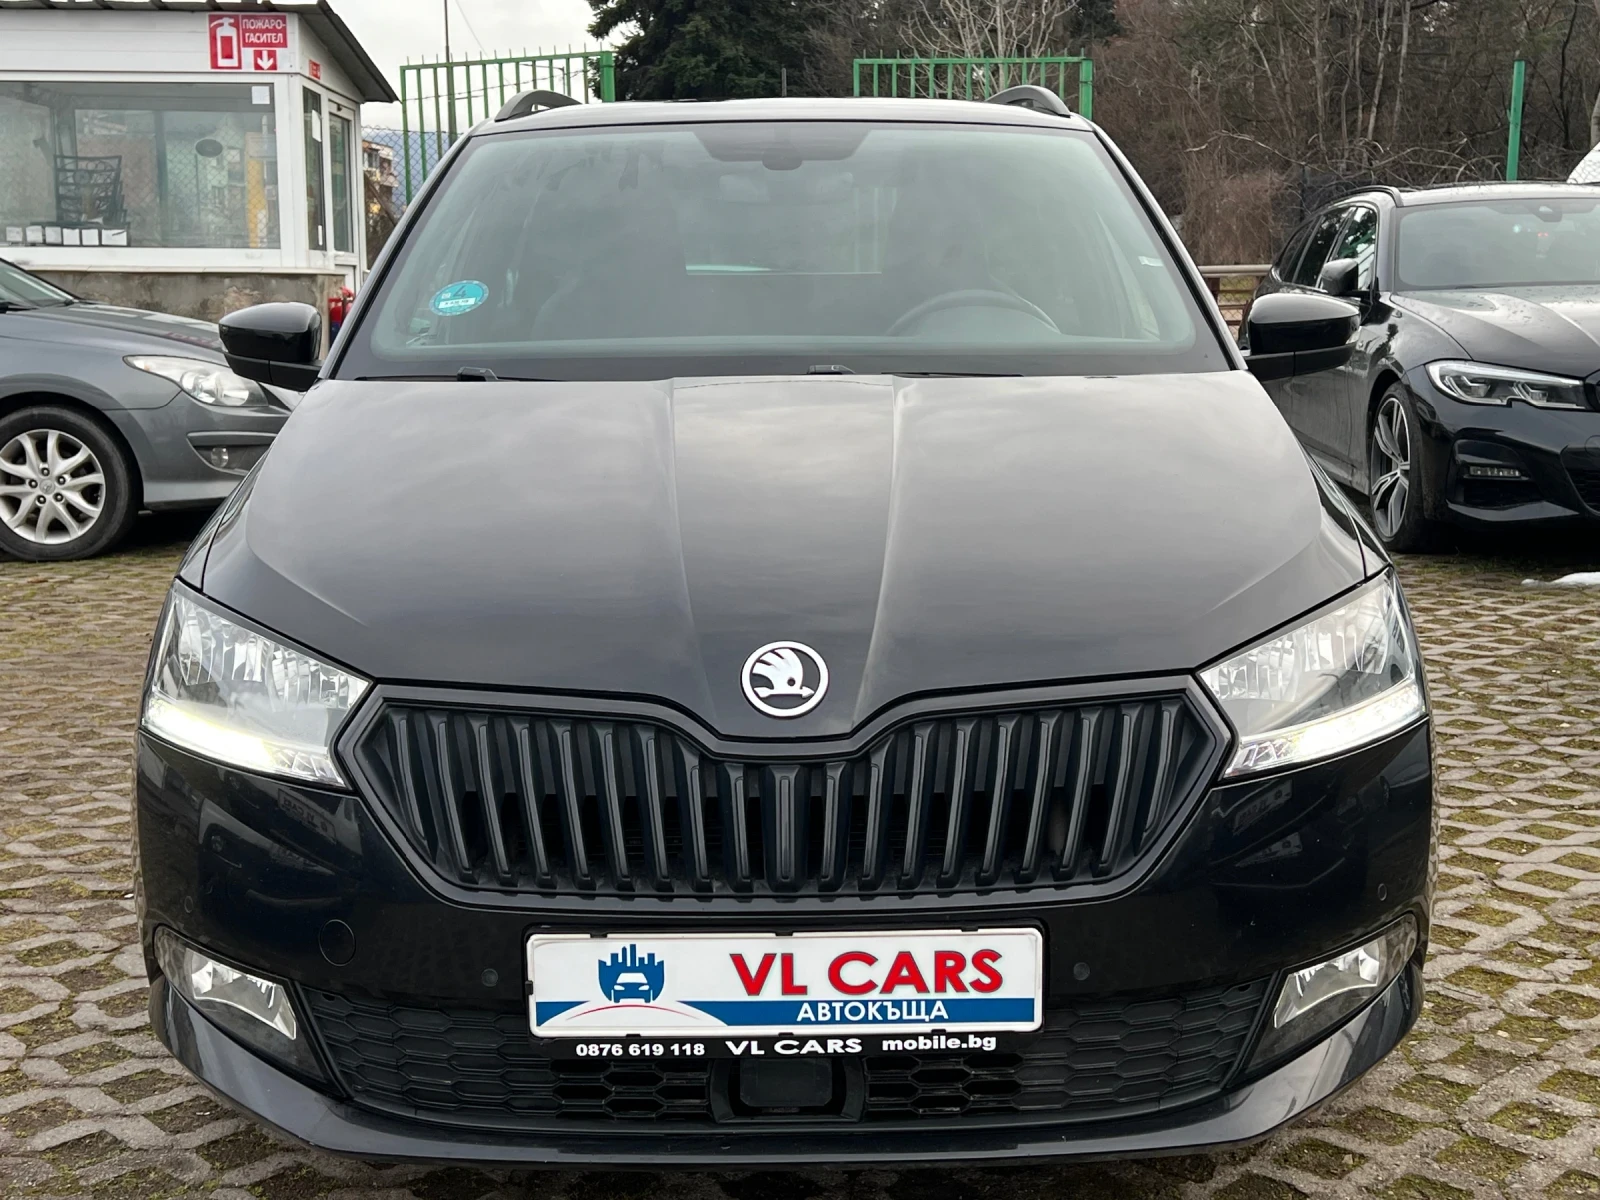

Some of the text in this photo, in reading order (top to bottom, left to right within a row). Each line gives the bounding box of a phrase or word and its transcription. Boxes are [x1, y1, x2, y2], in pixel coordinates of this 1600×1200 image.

[243, 19, 286, 30] ПОЖАРО-
[245, 33, 283, 43] ГАСИТЕЛ
[452, 284, 467, 298] 4
[729, 949, 1004, 996] VL CARS
[796, 1000, 949, 1022] АВТОКЪЩА
[575, 1034, 997, 1056] 0876 619 118 VL CARS mobile.bg
